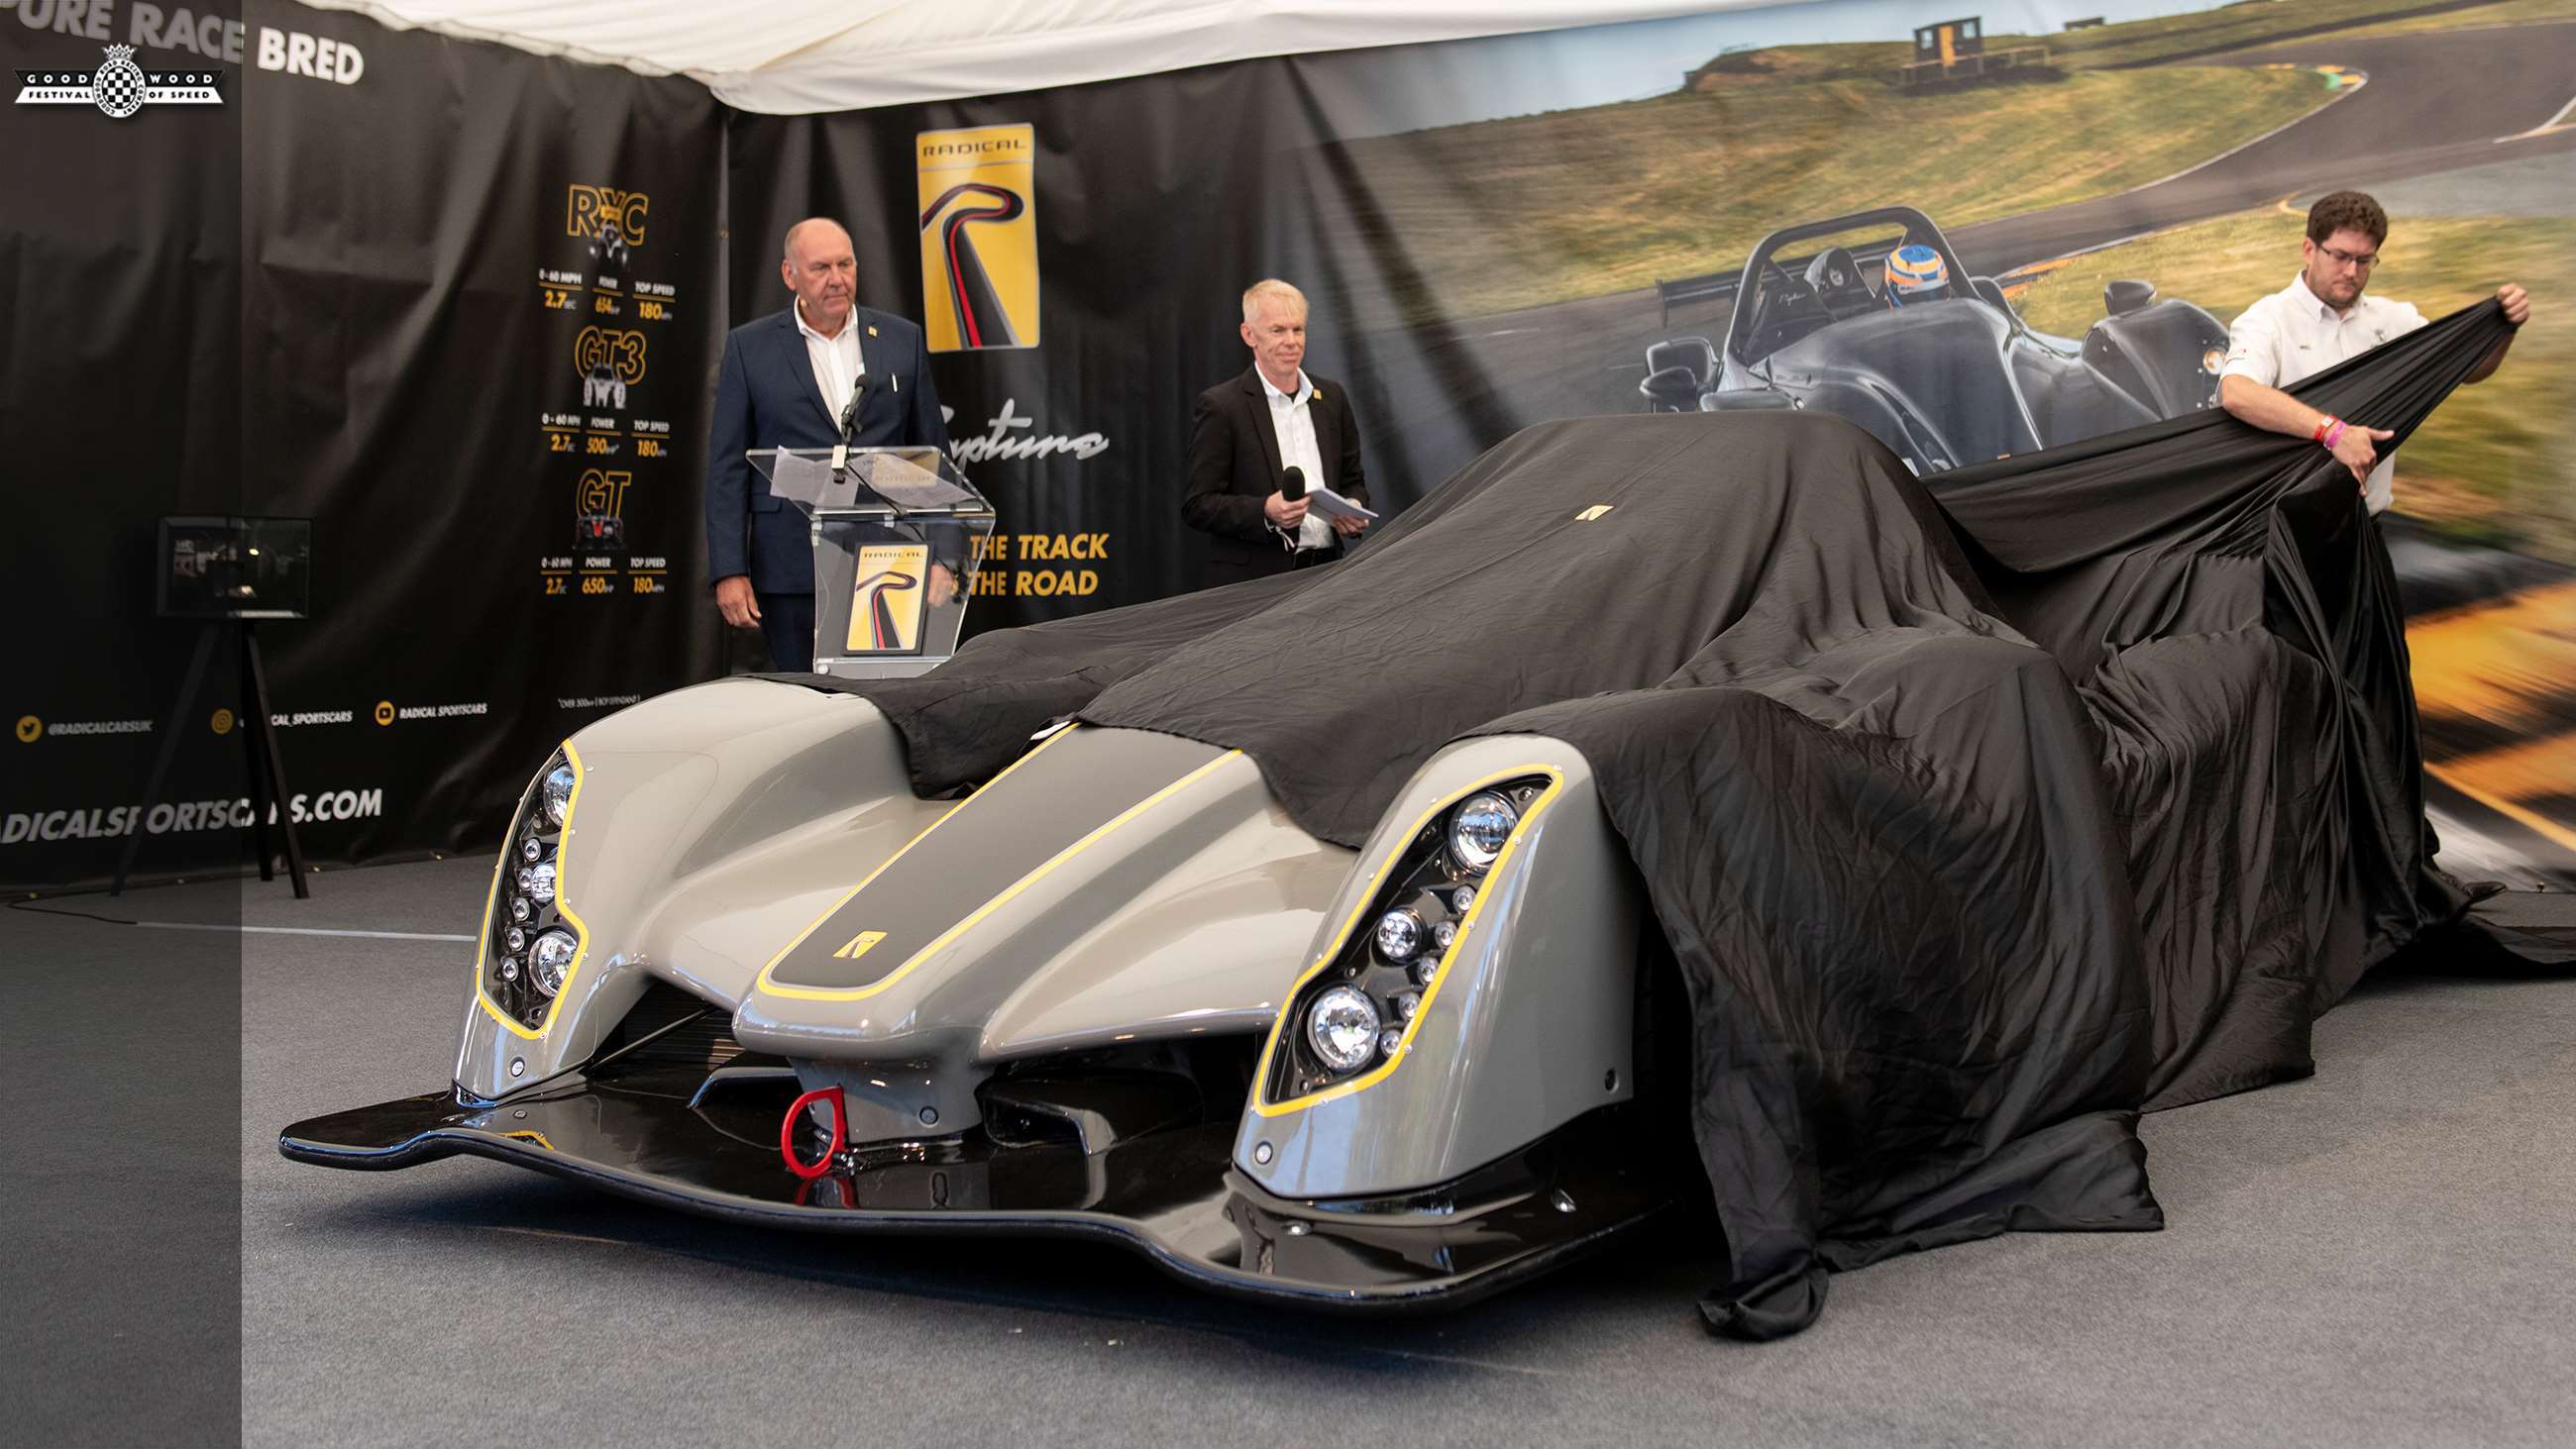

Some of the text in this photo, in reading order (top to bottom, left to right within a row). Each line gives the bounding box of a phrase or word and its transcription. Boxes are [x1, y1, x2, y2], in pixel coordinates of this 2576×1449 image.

[0, 0, 364, 84] URE RACE BRED
[923, 140, 1026, 156] RADICAL
[635, 281, 675, 296] TOP SPEED
[575, 324, 646, 385] GT3
[576, 467, 632, 520] GT
[969, 533, 1110, 560] THE TRACK
[586, 557, 611, 569] POWER
[630, 557, 666, 569] TOP SPEED
[968, 570, 1099, 596] THE ROAD
[399, 703, 487, 719] RADICAL SPORTSCARS
